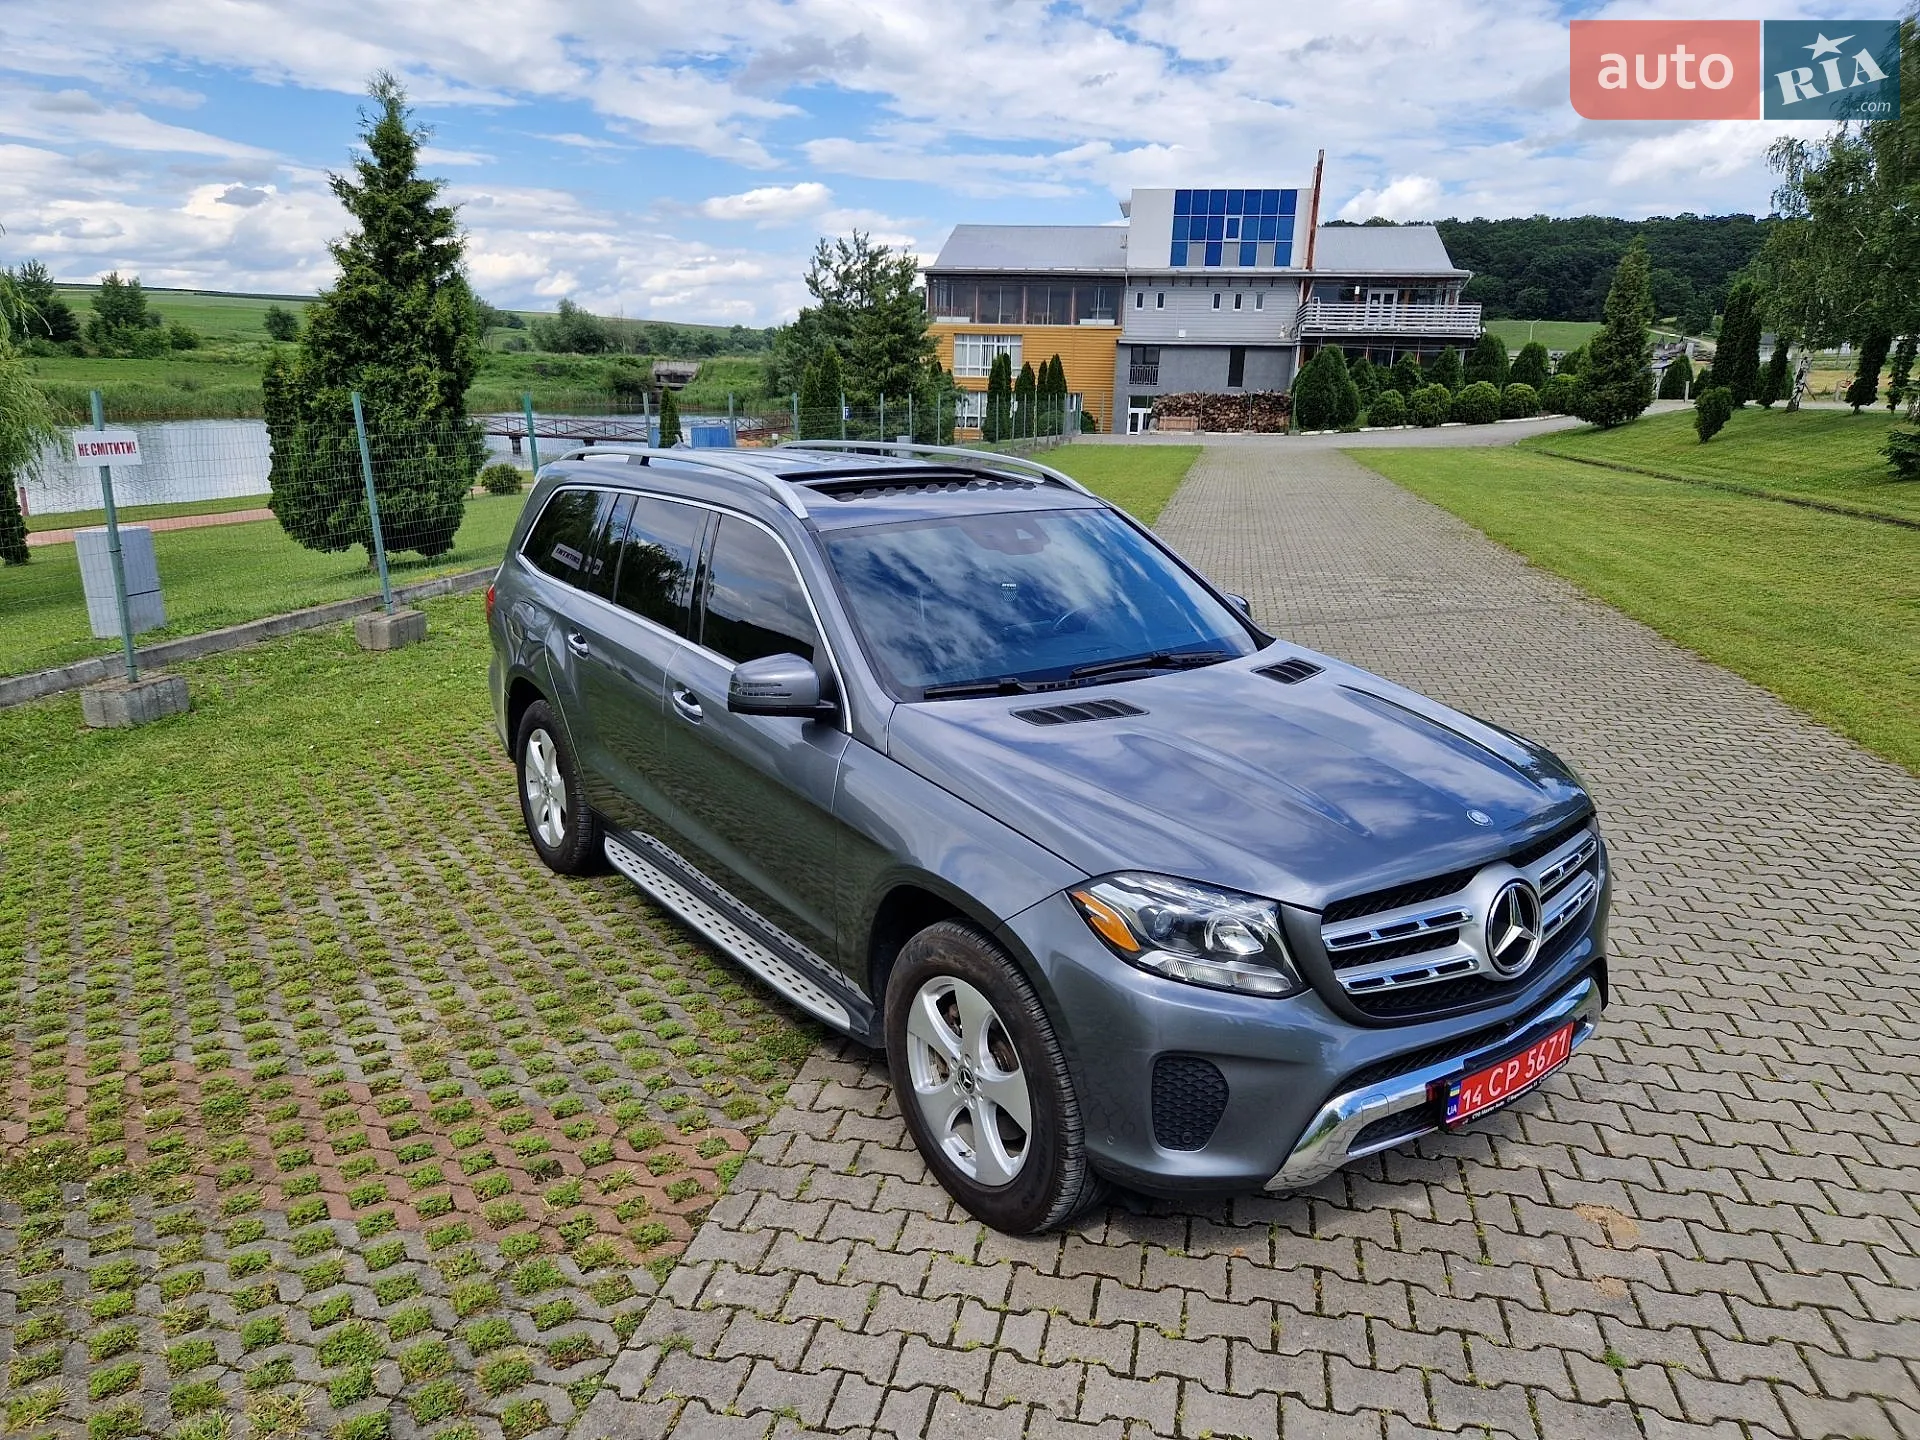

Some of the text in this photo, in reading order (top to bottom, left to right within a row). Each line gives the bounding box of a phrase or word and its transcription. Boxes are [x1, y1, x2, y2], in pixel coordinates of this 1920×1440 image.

[78, 441, 137, 456] НЕ СМІТИТИ!
[1462, 1084, 1483, 1110] 14
[1488, 1060, 1520, 1097] CP
[1525, 1028, 1569, 1079] 5671
[1447, 1104, 1457, 1116] UA
